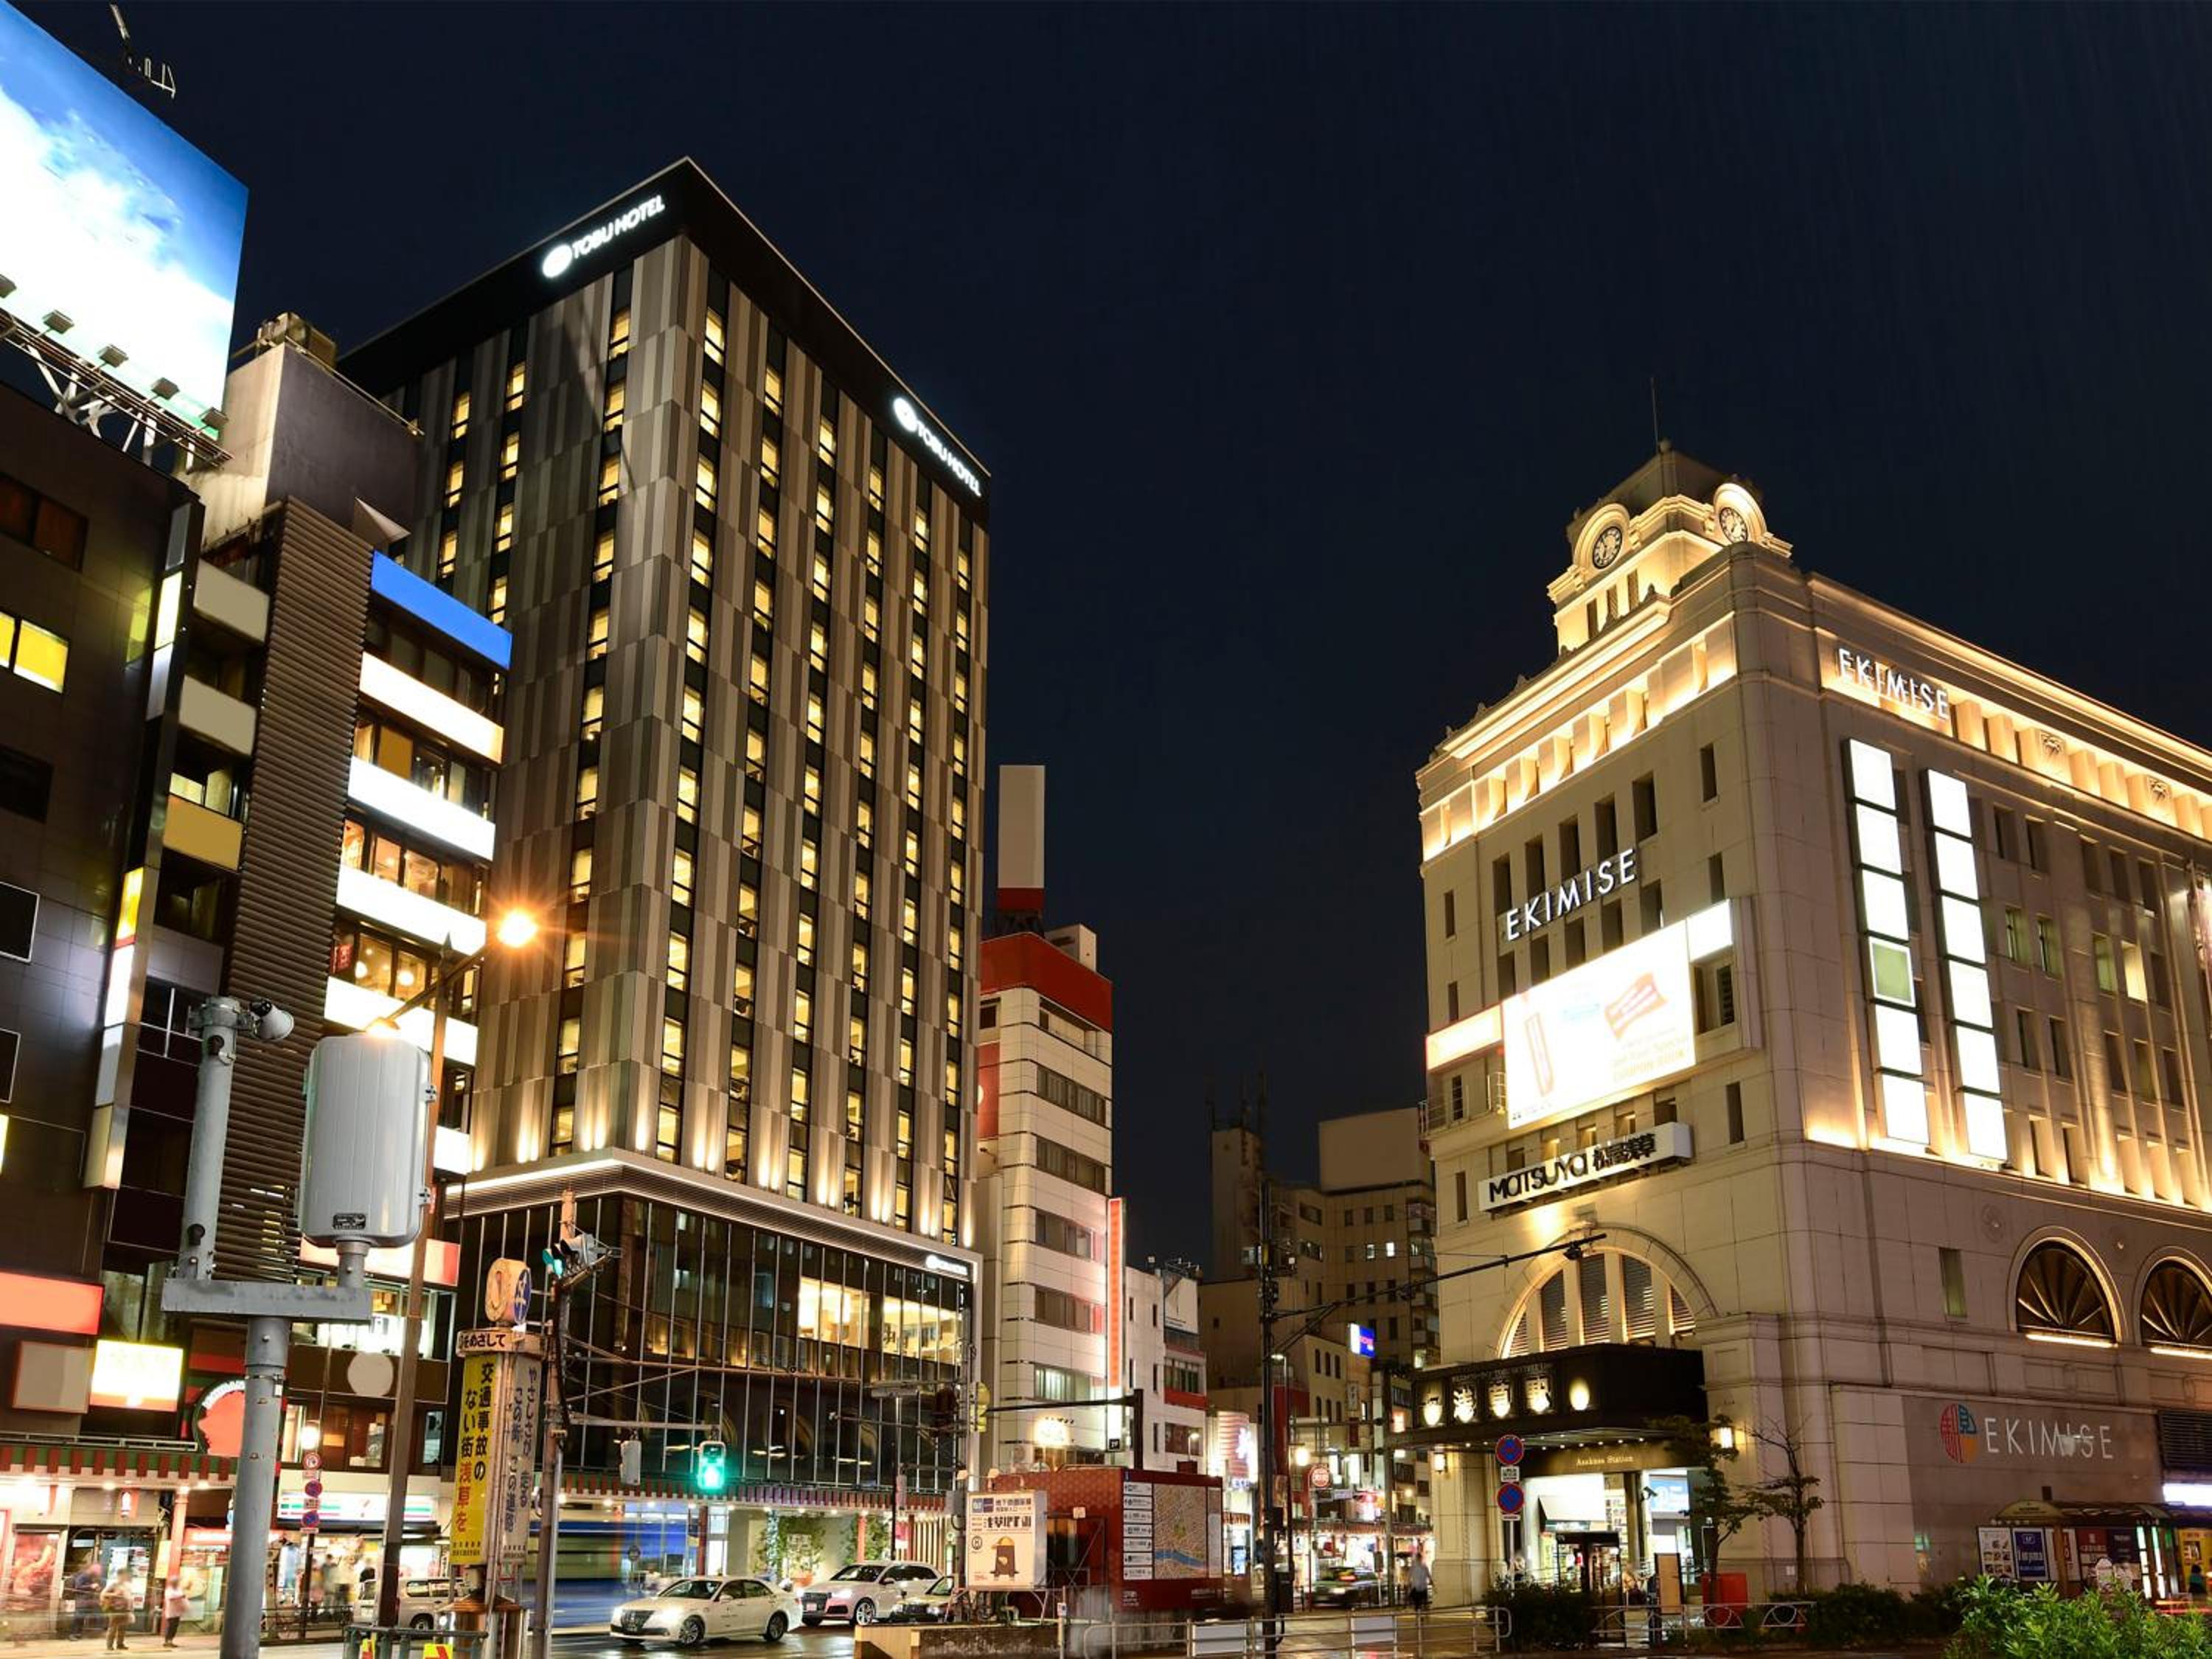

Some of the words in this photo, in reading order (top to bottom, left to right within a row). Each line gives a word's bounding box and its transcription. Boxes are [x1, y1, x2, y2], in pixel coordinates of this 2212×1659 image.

[572, 222, 613, 258] TOBU
[614, 195, 665, 235] HOTEL
[917, 420, 947, 462] TOBU
[947, 451, 981, 497] HOTEL
[1838, 648, 1950, 720] EKIMISE
[1506, 849, 1635, 942] EKIMISE
[474, 1363, 494, 1481] 交通事故の
[1576, 1456, 1605, 1467] Asakusa
[1607, 1455, 1634, 1464] Station
